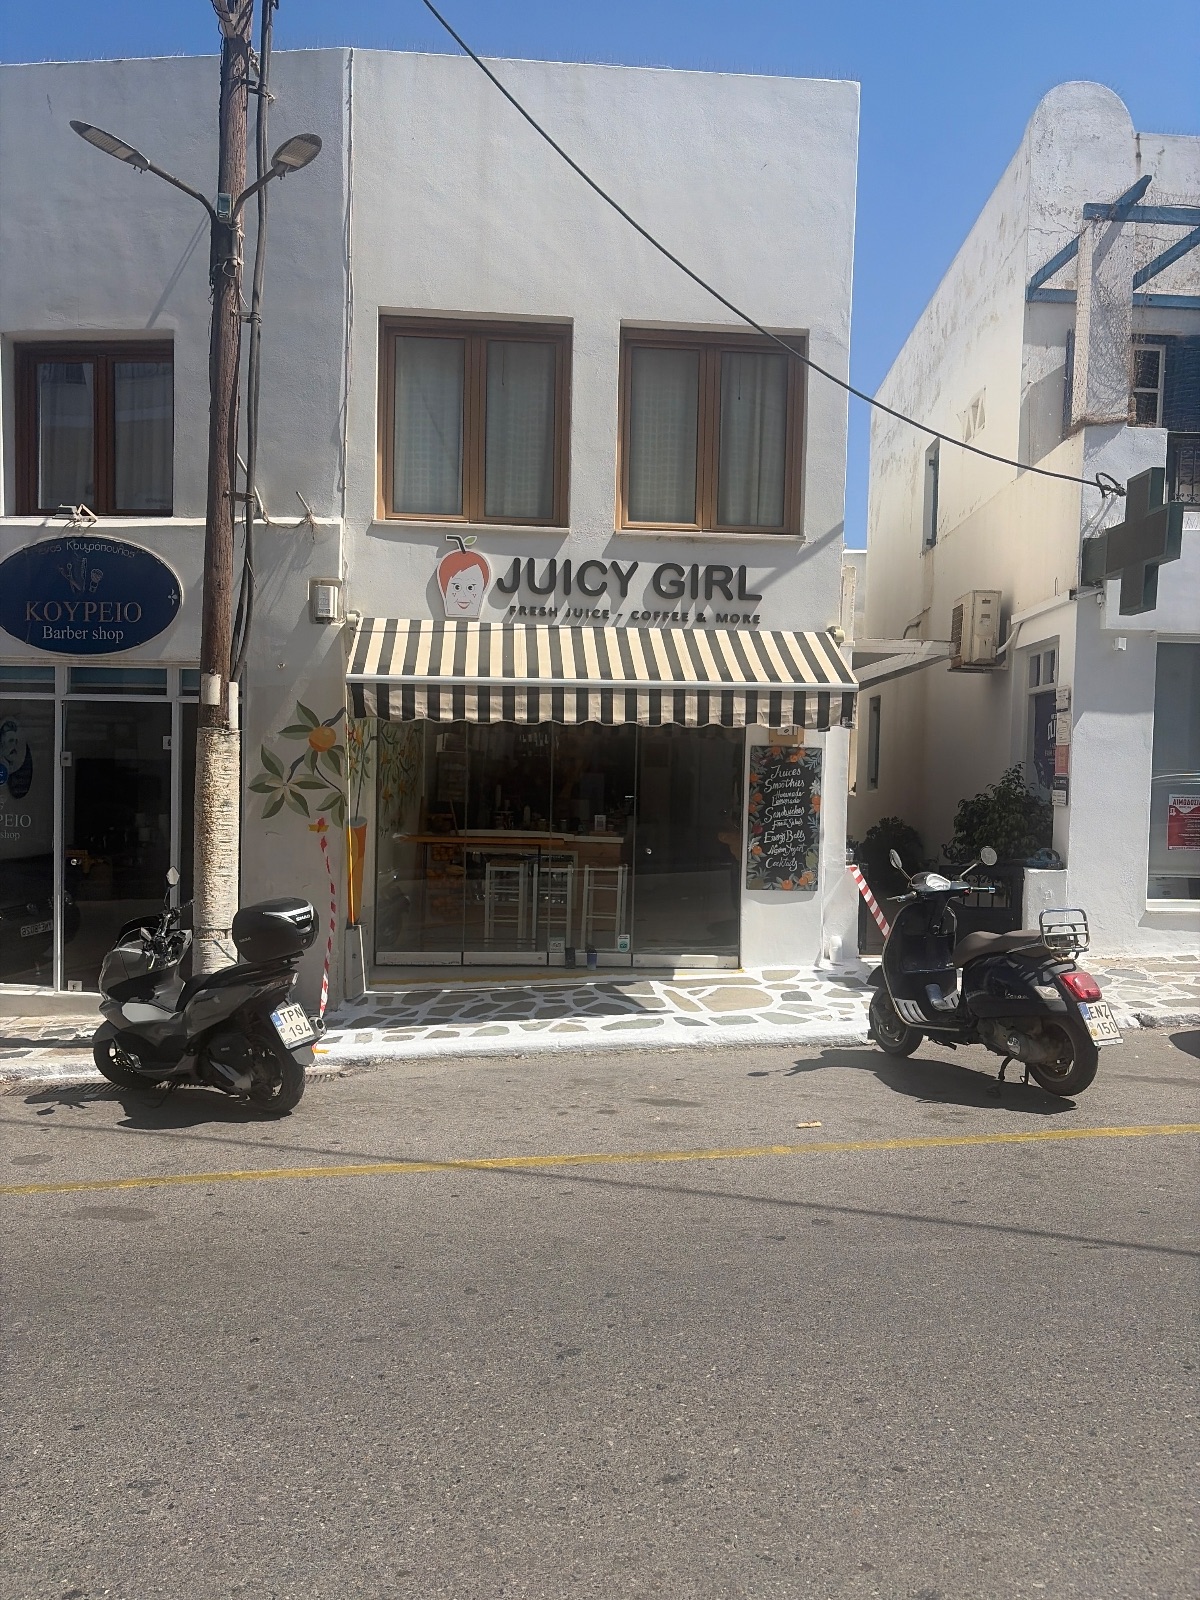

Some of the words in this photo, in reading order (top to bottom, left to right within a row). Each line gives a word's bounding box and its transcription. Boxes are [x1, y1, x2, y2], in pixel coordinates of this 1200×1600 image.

[496, 557, 639, 598] JUICY
[652, 562, 763, 601] GIRL
[25, 600, 142, 623] ΚΟΥΡΕΙΟ
[509, 605, 558, 617] FRESH
[565, 607, 610, 619] JUICE
[630, 610, 689, 622] COFFEE
[696, 612, 707, 623] &
[715, 613, 760, 624] MORE
[42, 625, 88, 640] Barber
[92, 626, 124, 643] shop
[770, 764, 801, 779] Juices
[764, 778, 805, 793] Smoothies
[1, 830, 20, 841] shop
[280, 1006, 304, 1024] TPN
[289, 1021, 311, 1038] 194
[1097, 1021, 1117, 1036] 150
